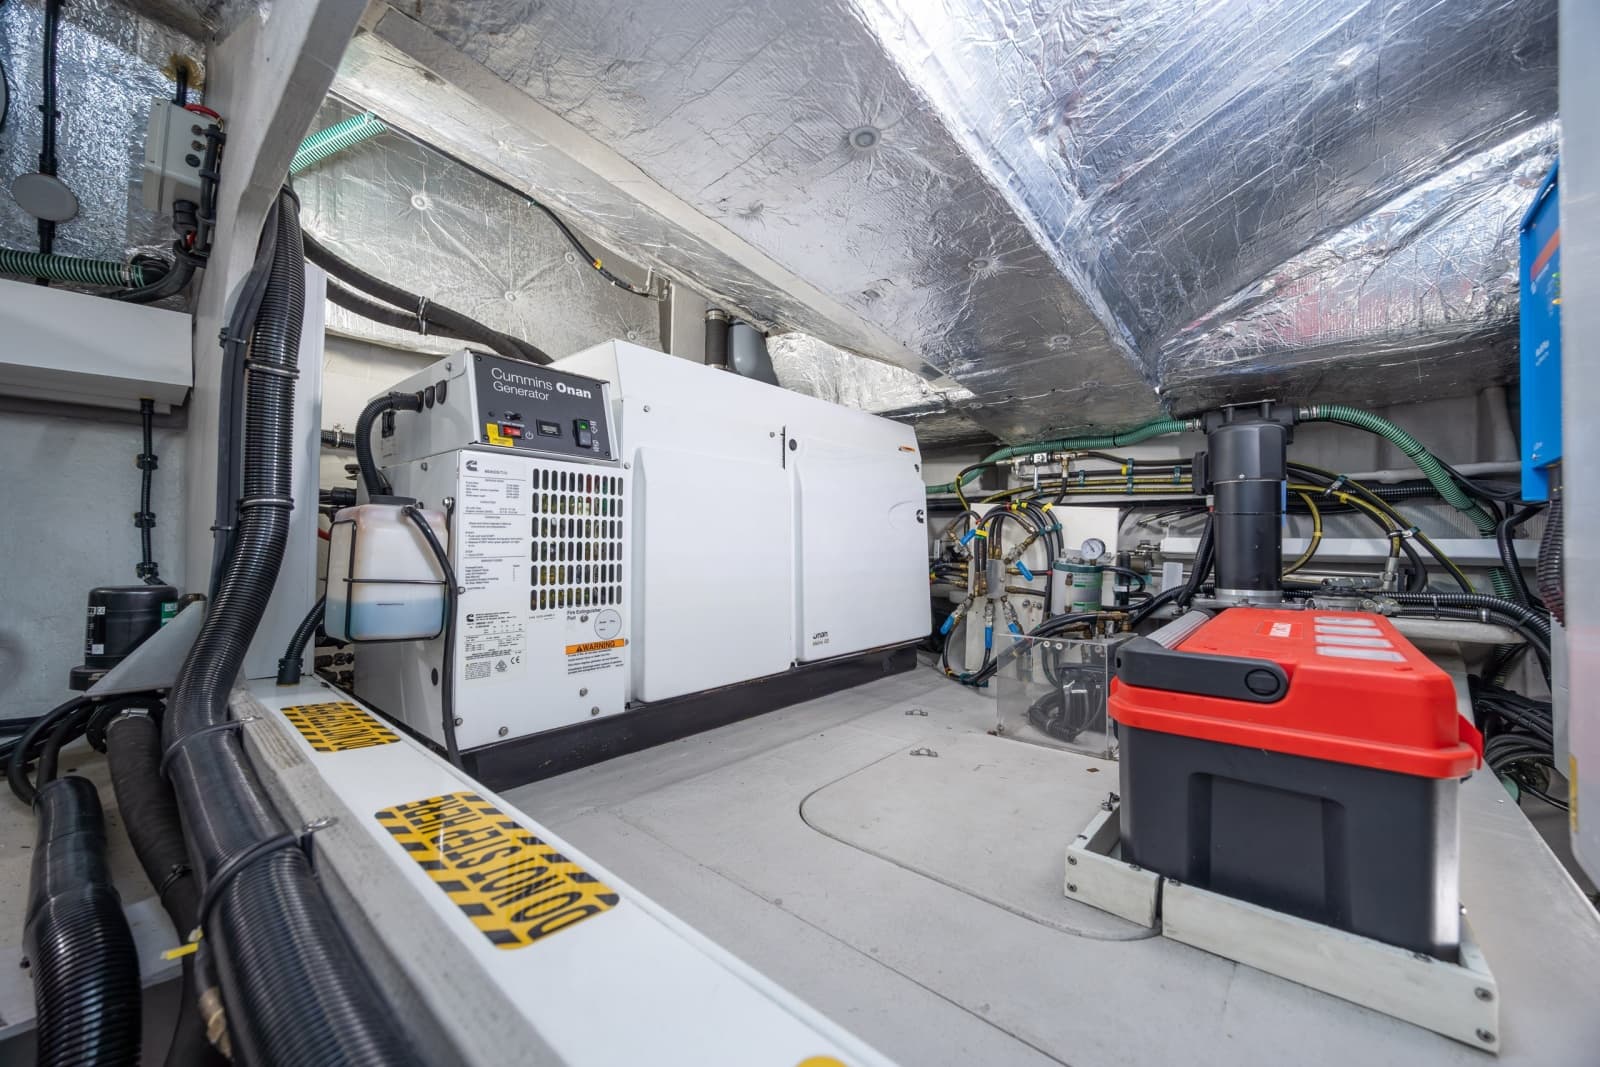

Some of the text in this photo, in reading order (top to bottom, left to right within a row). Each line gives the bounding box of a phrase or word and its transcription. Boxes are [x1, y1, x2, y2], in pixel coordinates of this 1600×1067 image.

[491, 368, 592, 399] Cummins Onan
[493, 381, 549, 401] Generator
[583, 640, 616, 651] WARNING
[395, 793, 602, 941] DO NOT STEP HERE
